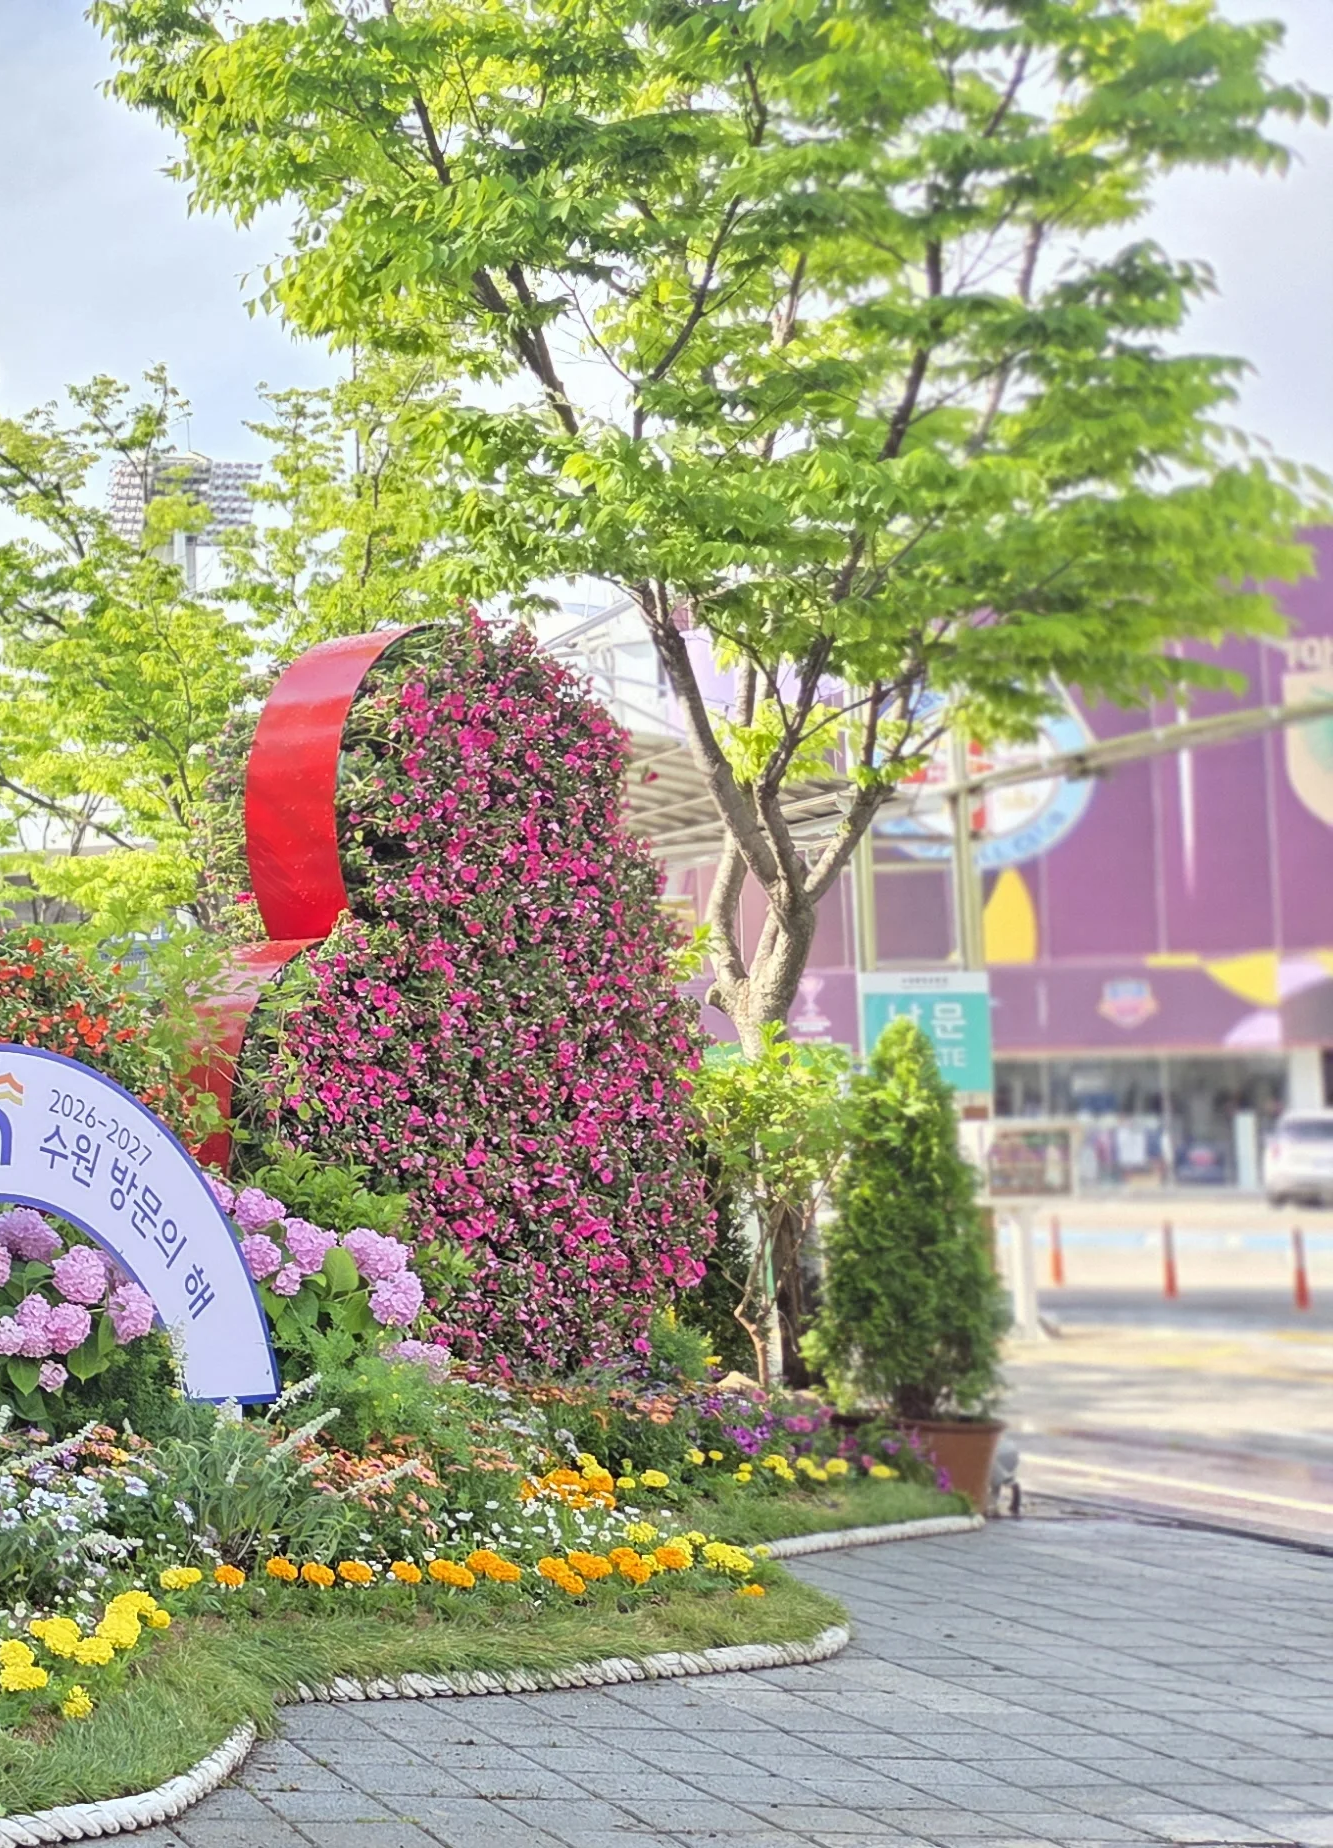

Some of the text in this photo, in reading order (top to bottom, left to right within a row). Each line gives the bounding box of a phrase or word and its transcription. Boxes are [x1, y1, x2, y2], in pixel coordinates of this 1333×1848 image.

[49, 1089, 153, 1166] 2026-2027
[39, 1124, 216, 1321] 수원 방문의 해
